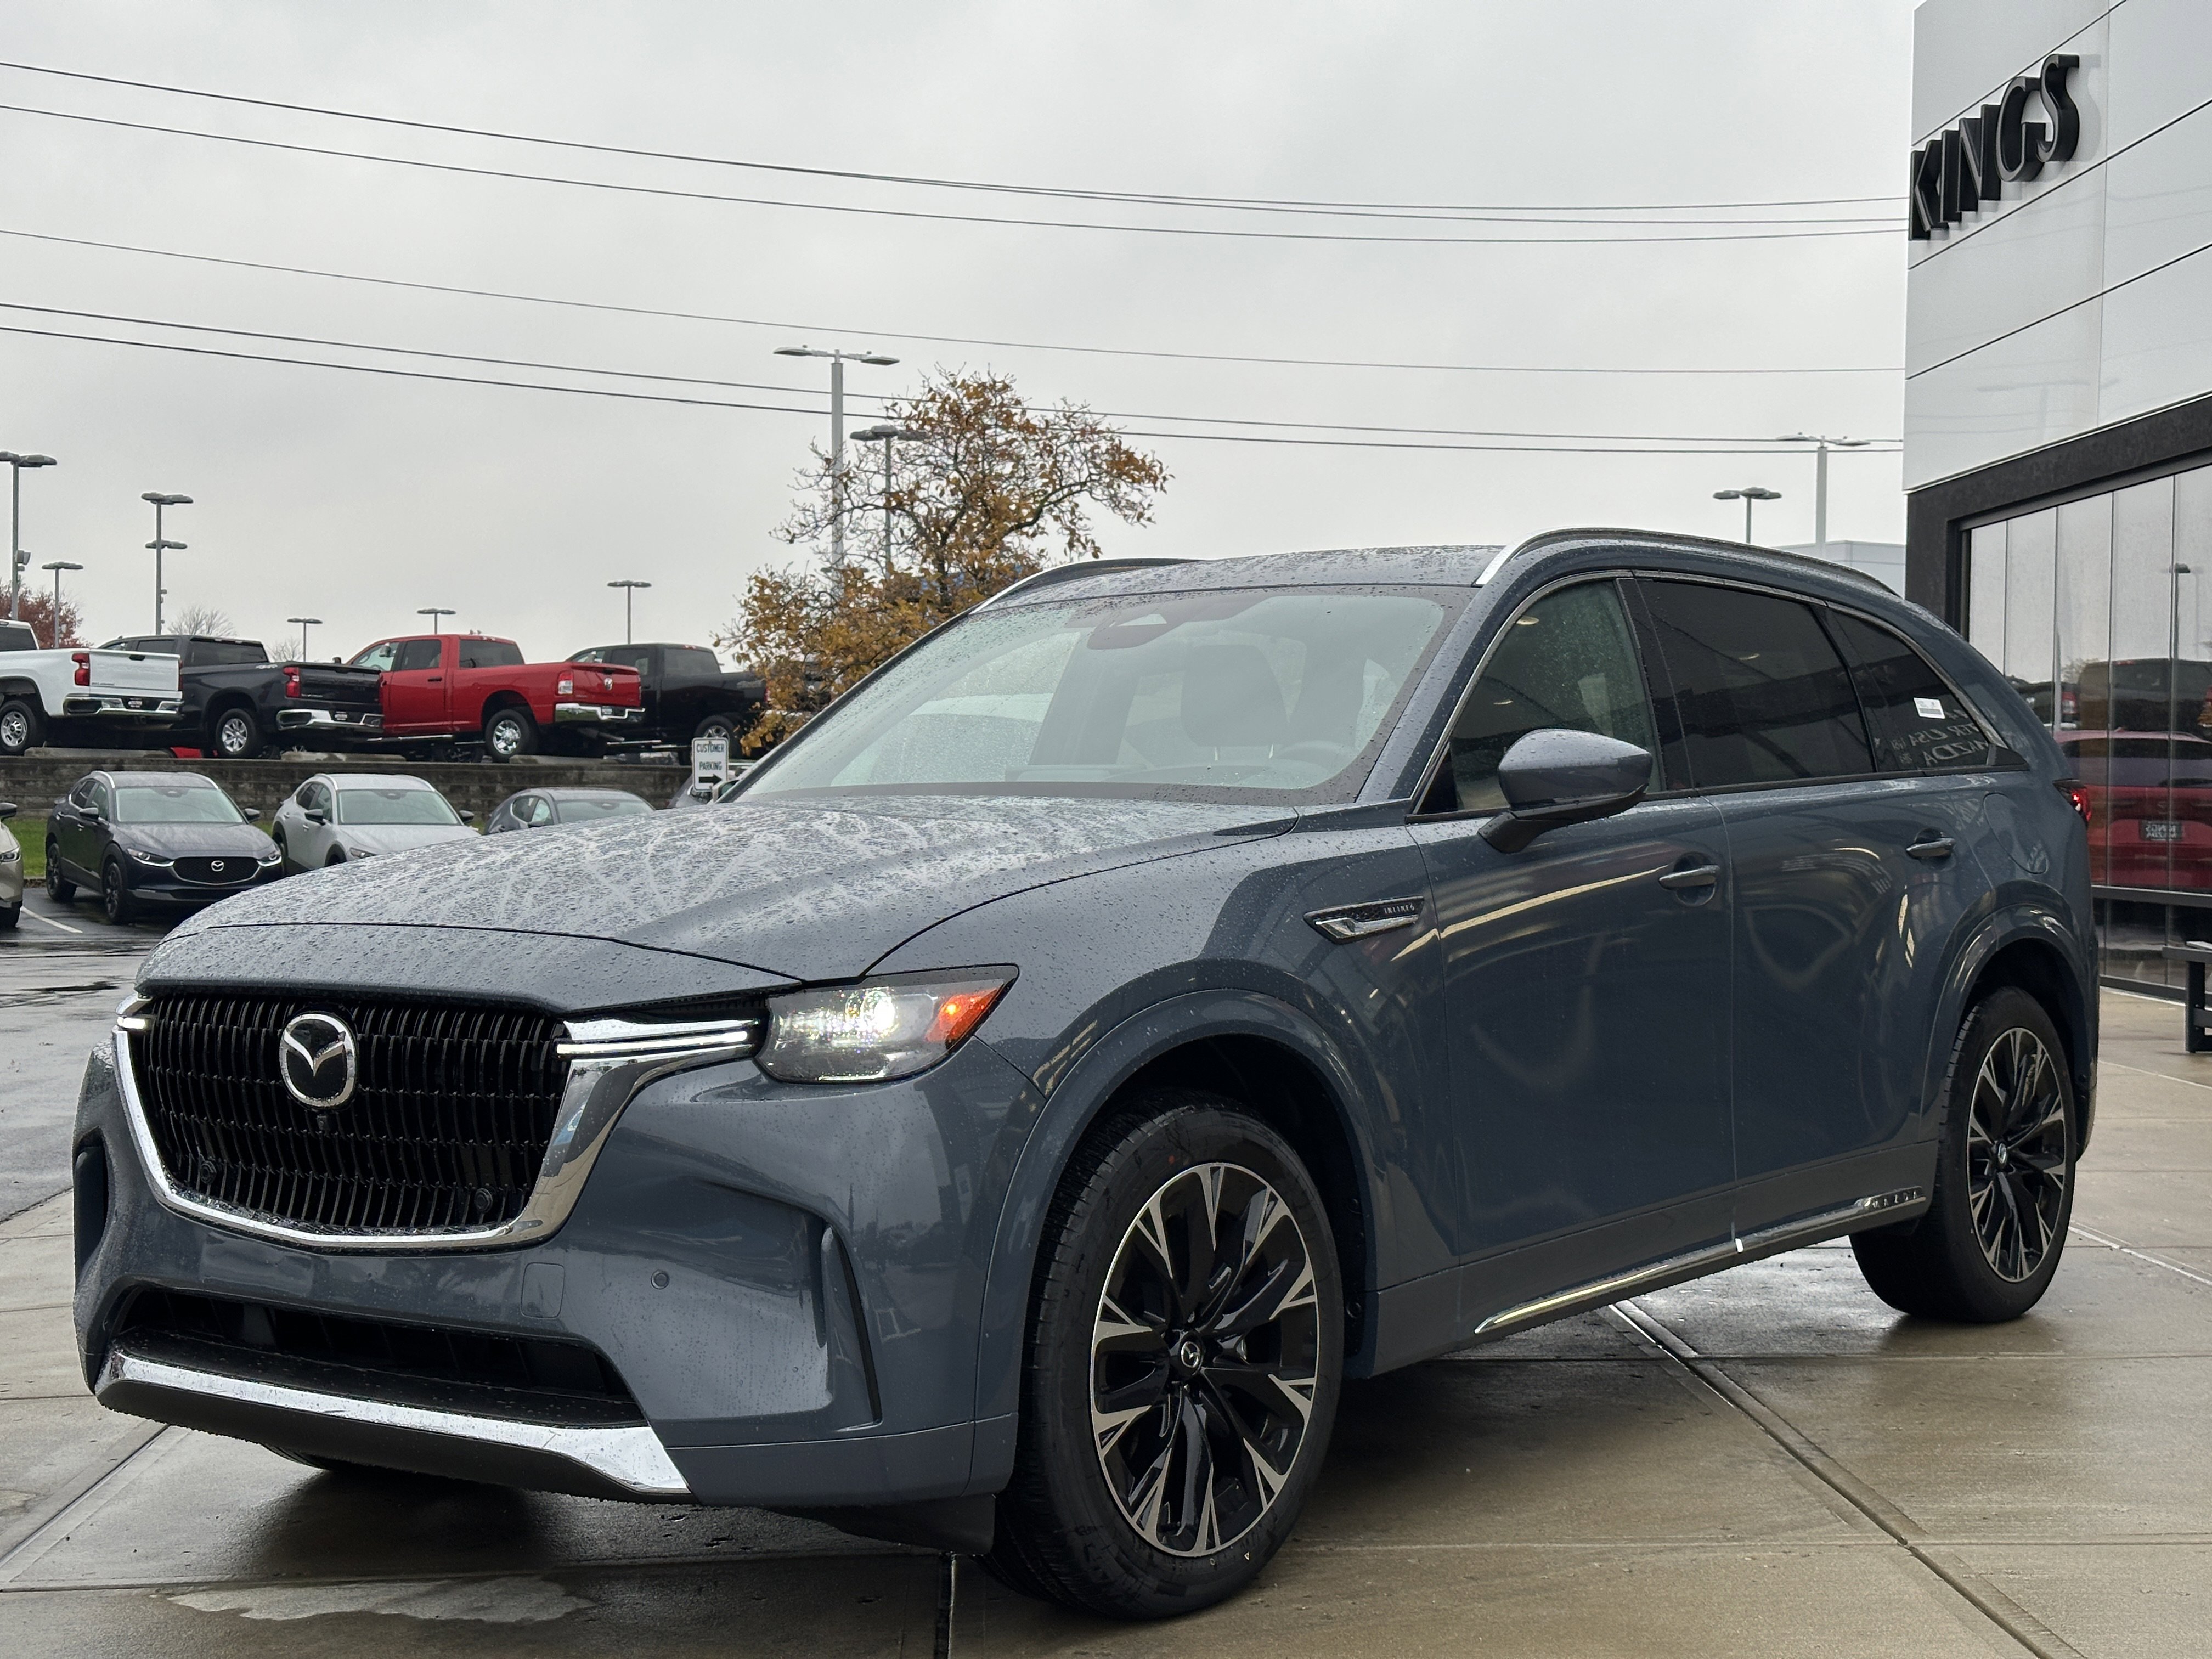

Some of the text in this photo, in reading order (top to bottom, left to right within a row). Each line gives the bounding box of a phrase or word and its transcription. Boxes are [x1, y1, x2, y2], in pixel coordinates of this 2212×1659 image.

[1909, 53, 2080, 241] KINGS
[696, 743, 725, 753] CUSTOMER
[699, 761, 722, 770] PARKING
[1871, 1190, 1918, 1209] MAZDA
